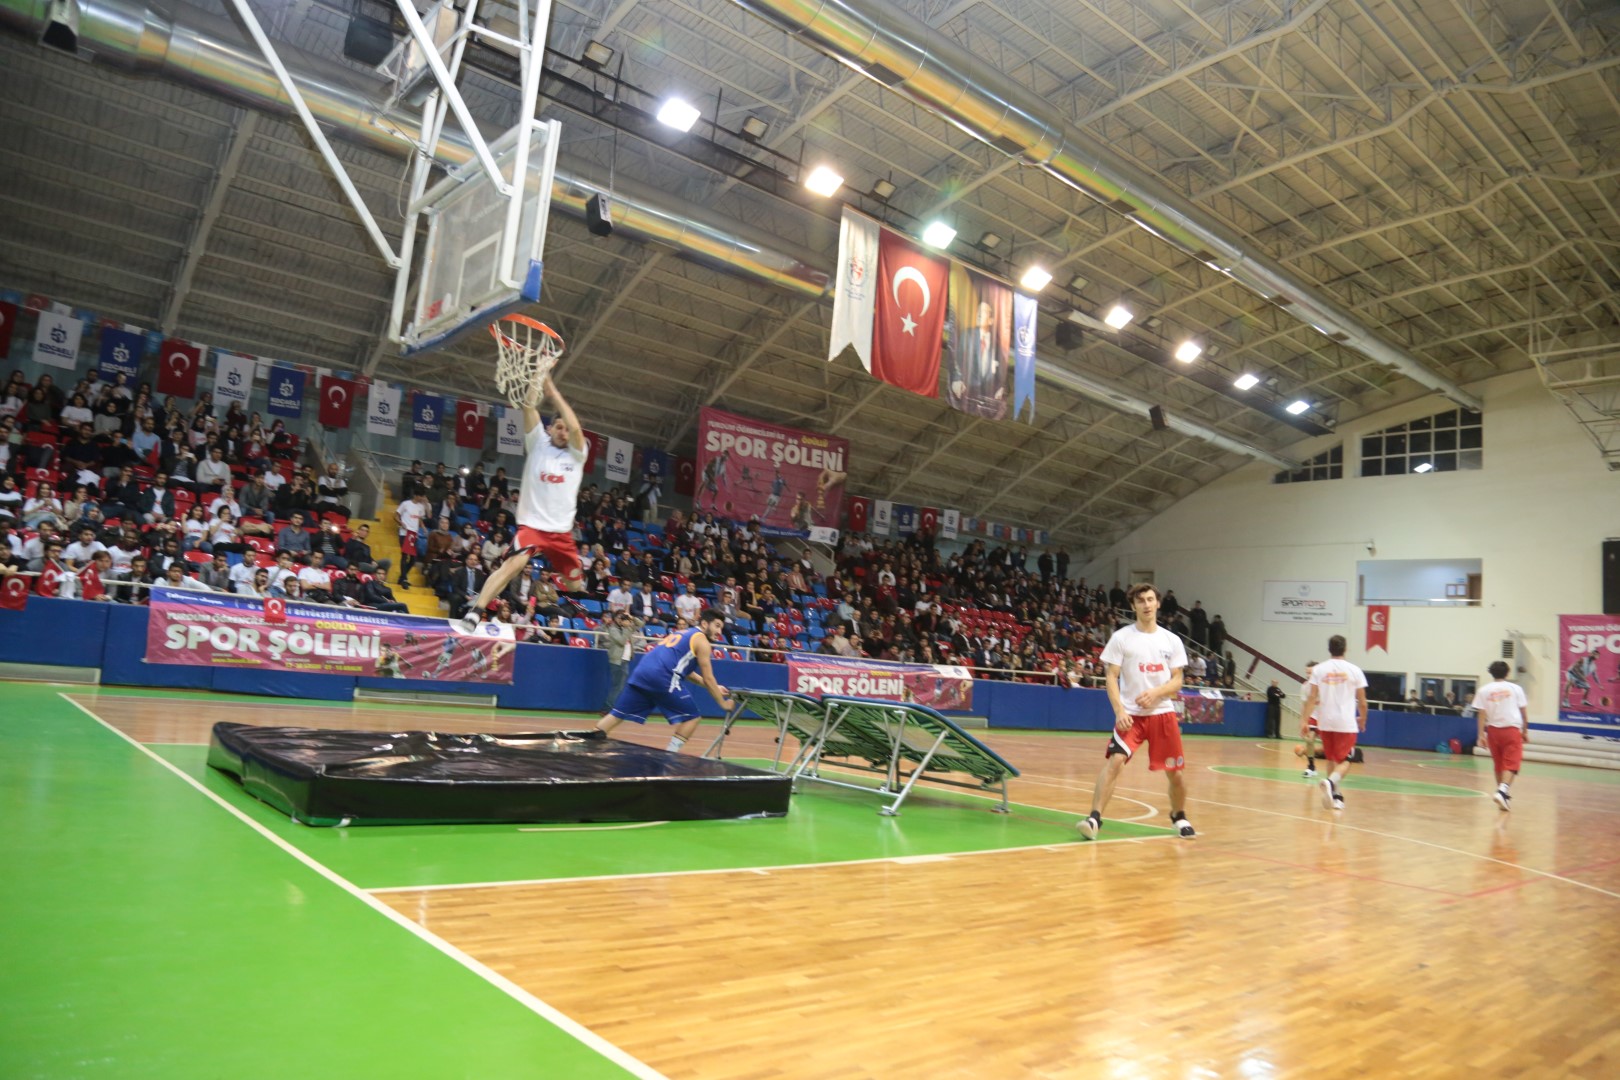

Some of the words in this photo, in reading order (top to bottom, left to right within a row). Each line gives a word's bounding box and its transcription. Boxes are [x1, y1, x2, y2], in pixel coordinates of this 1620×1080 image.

[704, 430, 767, 460] SPOR
[771, 437, 844, 472] ŞÖLENİ
[164, 623, 261, 652] SPOR
[267, 624, 380, 660] ŞÖLENİ
[796, 675, 845, 695] SPOR
[847, 673, 904, 697] ŞÖLENİ
